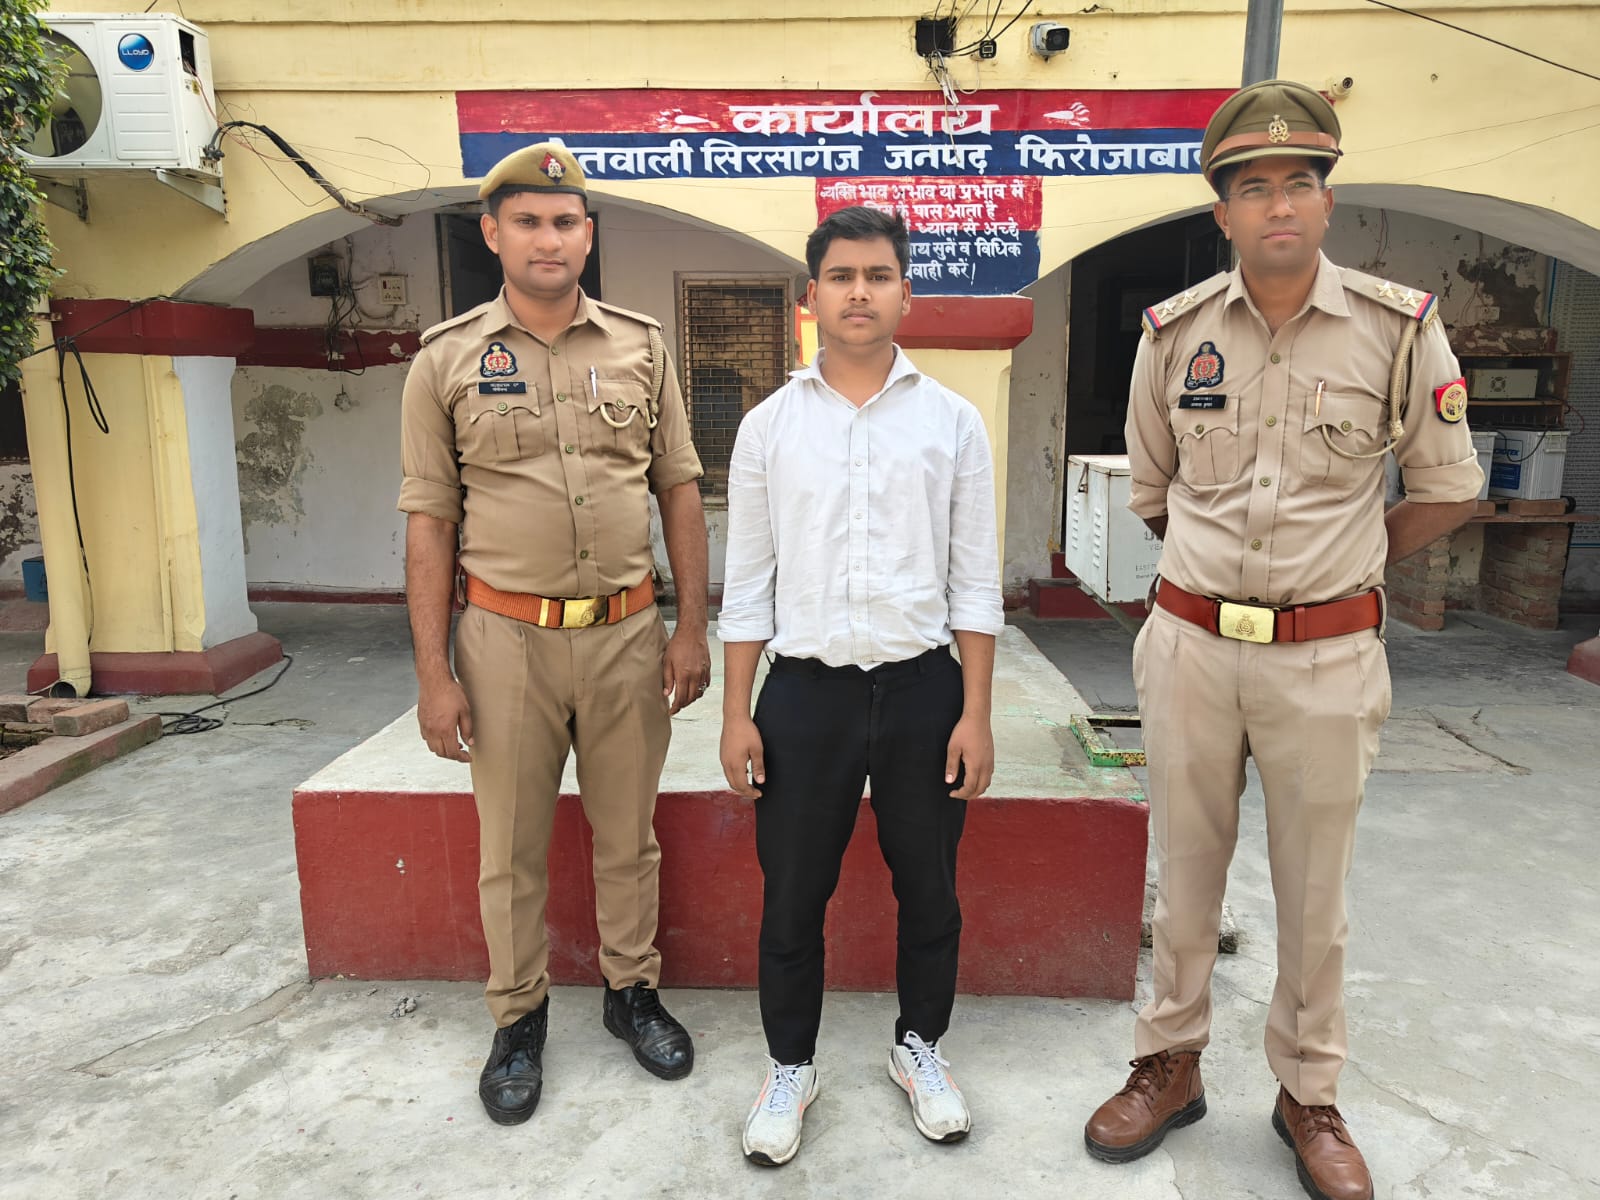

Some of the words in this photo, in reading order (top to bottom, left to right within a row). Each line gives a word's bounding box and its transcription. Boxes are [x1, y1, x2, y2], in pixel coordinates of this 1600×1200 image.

[121, 48, 150, 56] LLOYD
[729, 91, 1000, 137] कार्यालय
[548, 136, 695, 175] तवाली
[700, 138, 864, 175] सिरसागंज
[858, 184, 888, 201] भाव
[892, 184, 937, 201] अभाव
[938, 184, 957, 200] या
[958, 183, 1008, 202] प्रभाव
[945, 203, 984, 219] आता
[985, 199, 998, 220] है
[961, 216, 981, 237] से
[958, 241, 972, 257] व
[974, 236, 1023, 257] विधिक
